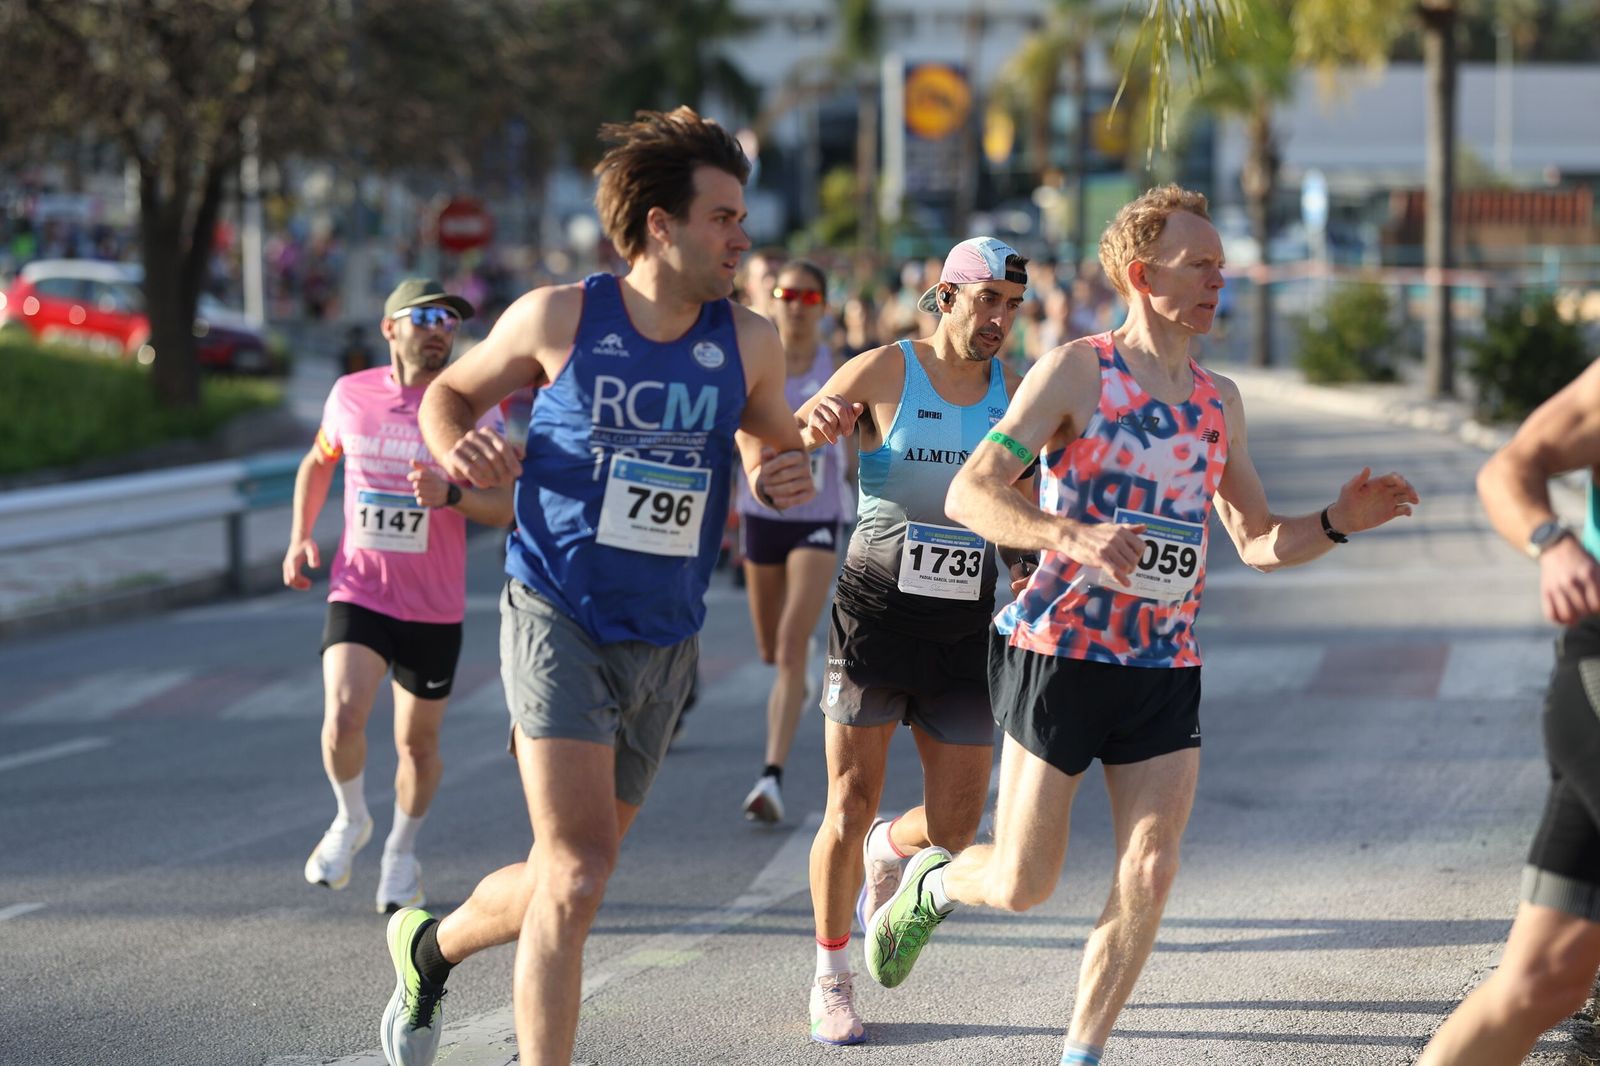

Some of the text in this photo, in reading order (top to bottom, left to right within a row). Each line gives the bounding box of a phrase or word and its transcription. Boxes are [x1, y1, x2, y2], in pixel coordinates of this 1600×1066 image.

[591, 374, 719, 431] RCM
[904, 447, 968, 465] ALMUÑ
[360, 507, 424, 532] 1147
[627, 485, 694, 527] 796
[909, 543, 982, 578] 1733
[1137, 539, 1198, 578] 059
